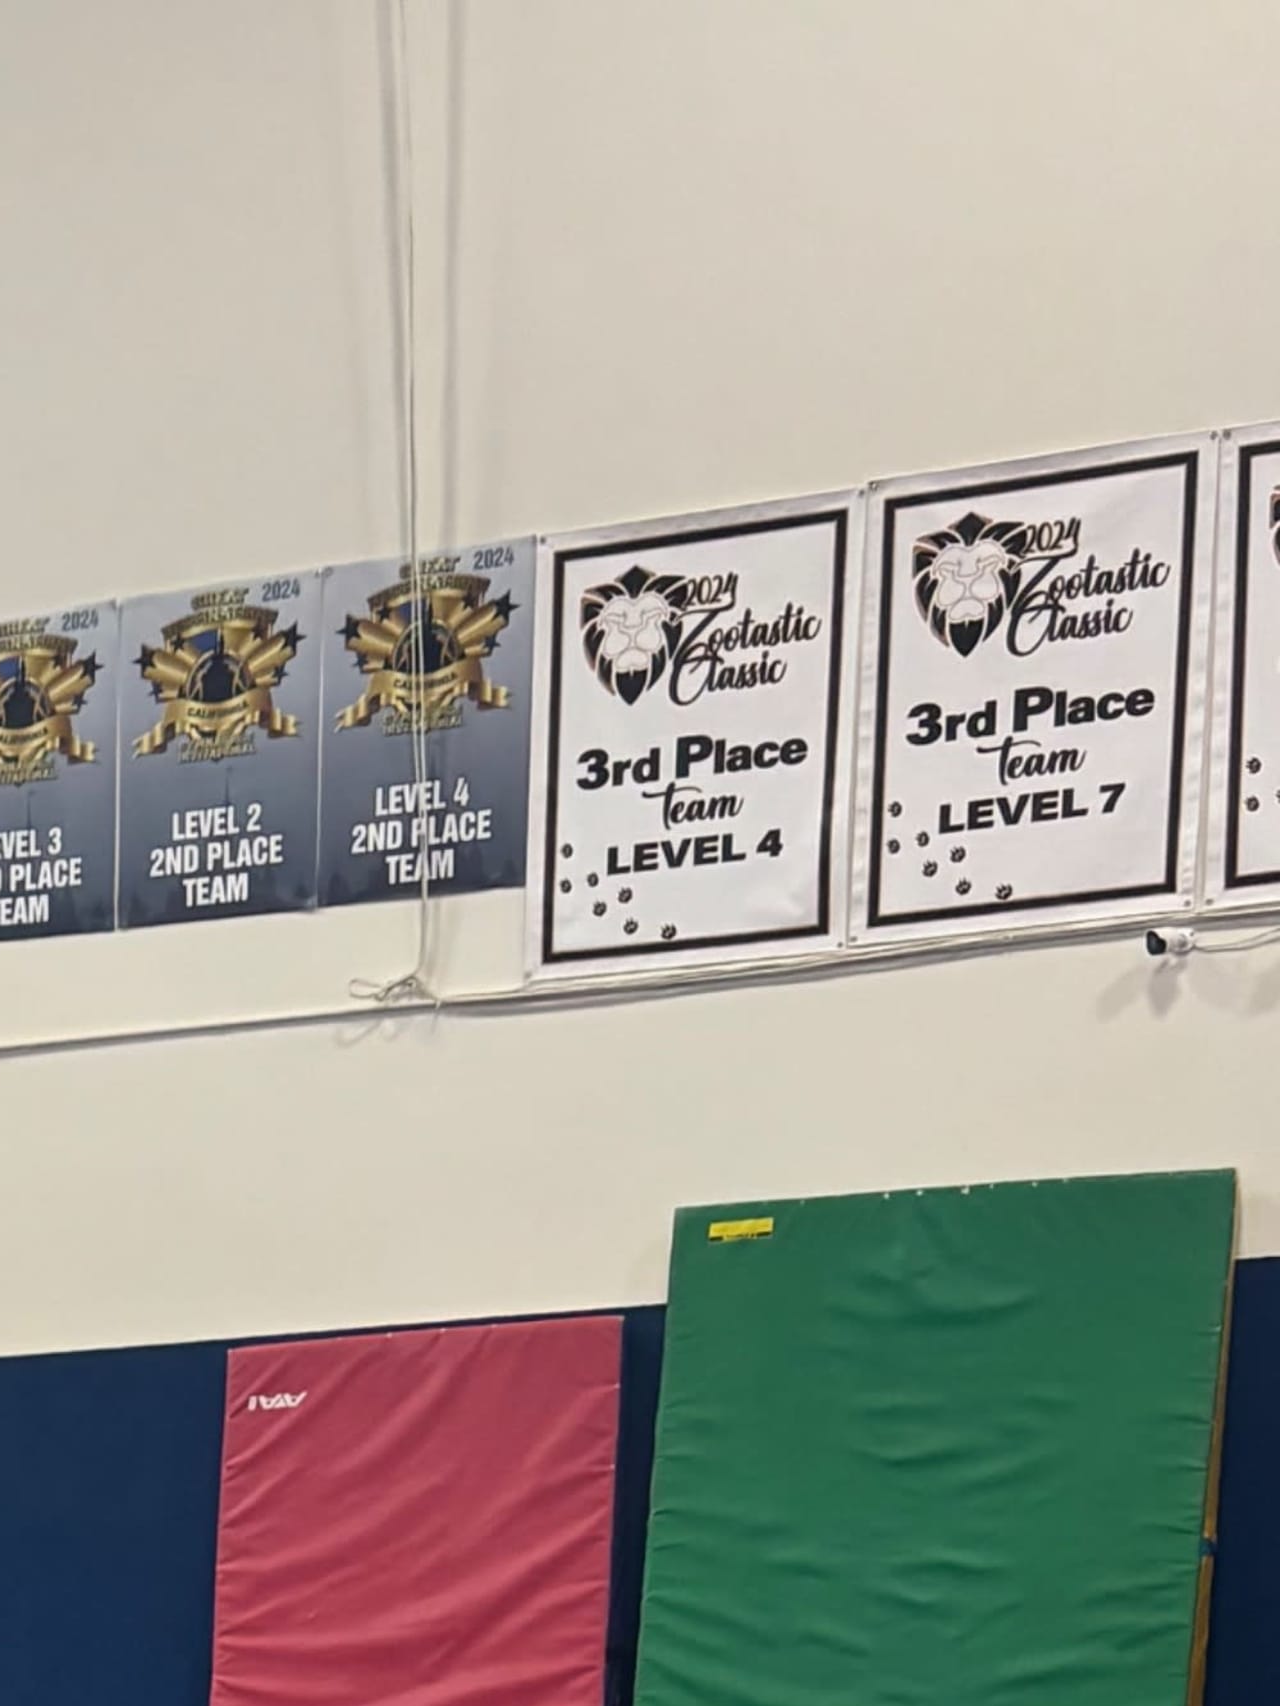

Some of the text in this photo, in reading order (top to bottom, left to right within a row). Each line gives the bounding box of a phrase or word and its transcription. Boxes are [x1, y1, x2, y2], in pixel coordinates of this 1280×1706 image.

[1024, 518, 1081, 556] 2024
[472, 547, 515, 571] 2024
[261, 578, 301, 602] 2024
[684, 572, 739, 608] 2024
[1011, 548, 1171, 612] Zootastic
[61, 610, 99, 632] 2024
[673, 602, 822, 661] Zootastic
[1006, 591, 1133, 657] Classic
[669, 643, 787, 706] Classic
[906, 686, 1155, 746] 3rd Place
[576, 735, 808, 790] 3rd Place
[375, 777, 469, 817] LEVEL 4
[939, 783, 1126, 834] LEVEL 7
[48, 827, 62, 854] 3
[172, 803, 262, 842] LEVEL 2
[351, 808, 492, 854] 2ND PLACE
[149, 834, 284, 878] 2ND PLACE
[385, 849, 454, 885] TEAM
[607, 829, 783, 876] LEVEL 4
[9, 857, 82, 892] PLACE
[183, 872, 248, 907] TEAM
